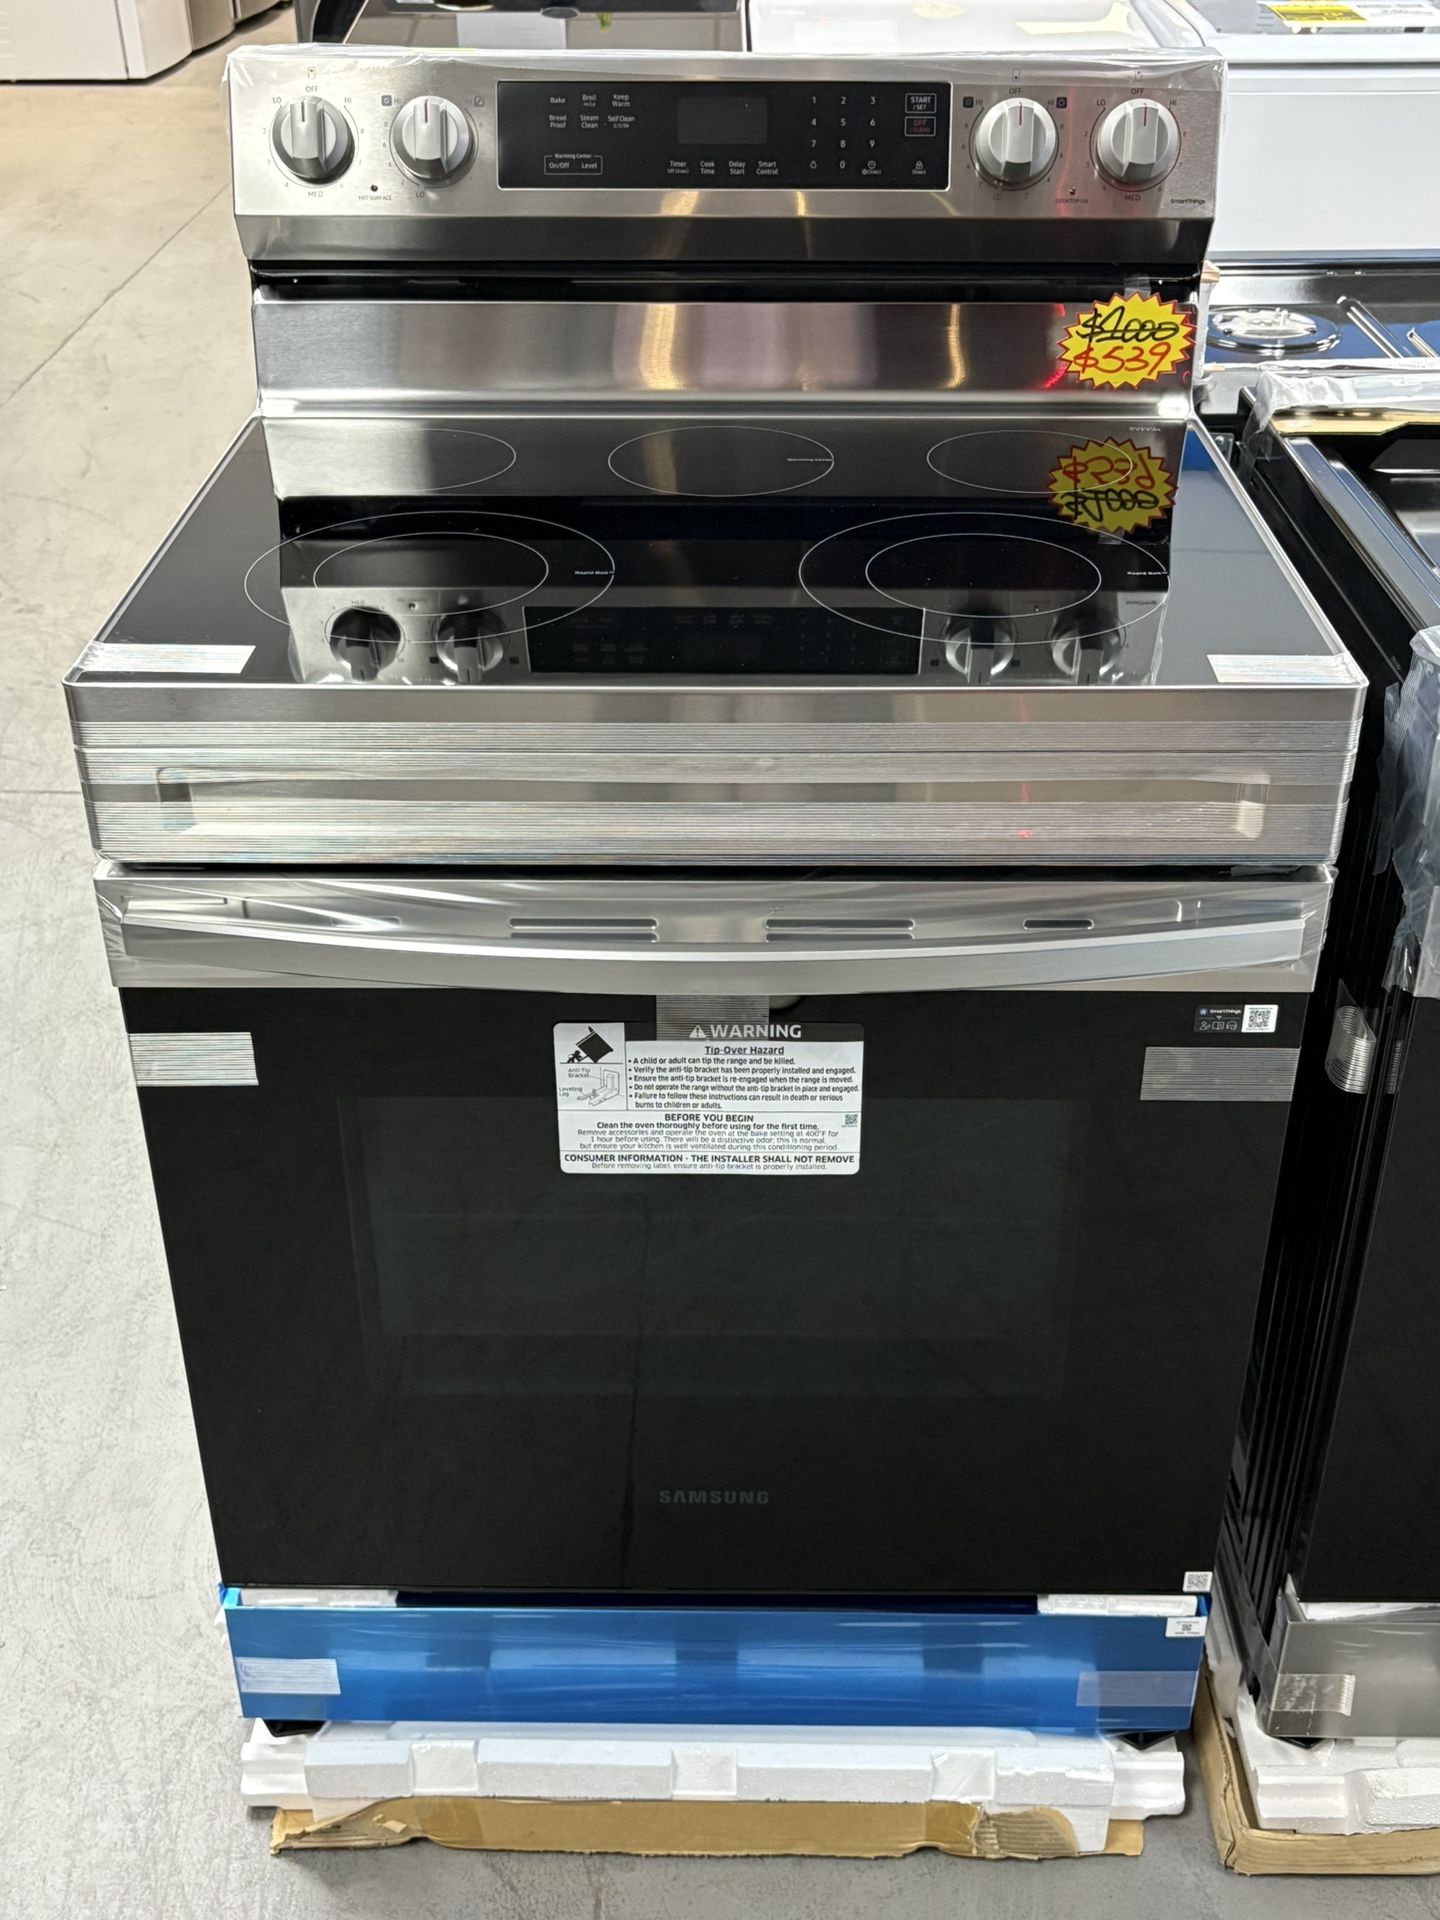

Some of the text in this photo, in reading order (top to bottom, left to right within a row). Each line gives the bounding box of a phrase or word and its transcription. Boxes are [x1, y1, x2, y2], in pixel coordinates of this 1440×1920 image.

[1074, 342, 1171, 376] $539
[710, 1024, 801, 1038] WARNING
[705, 1046, 784, 1055] Tip-Over Hazard
[702, 1058, 712, 1066] tip
[634, 1066, 654, 1074] Verify
[669, 1066, 692, 1074] anti-tip
[752, 1067, 780, 1075] properly
[826, 1067, 856, 1075] engaged.
[671, 1075, 694, 1084] anti-tip
[730, 1076, 767, 1084] re-engaged
[656, 1084, 679, 1092] operate
[747, 1085, 769, 1093] anti-tip
[802, 1085, 818, 1093] place
[832, 1085, 859, 1094] engaged.
[656, 1122, 700, 1131] thoroughly
[730, 1123, 751, 1131] using
[728, 1144, 751, 1152] during
[768, 1144, 812, 1152] conditioning
[814, 1144, 839, 1152] period.
[659, 1490, 769, 1504] SAMSUNG
